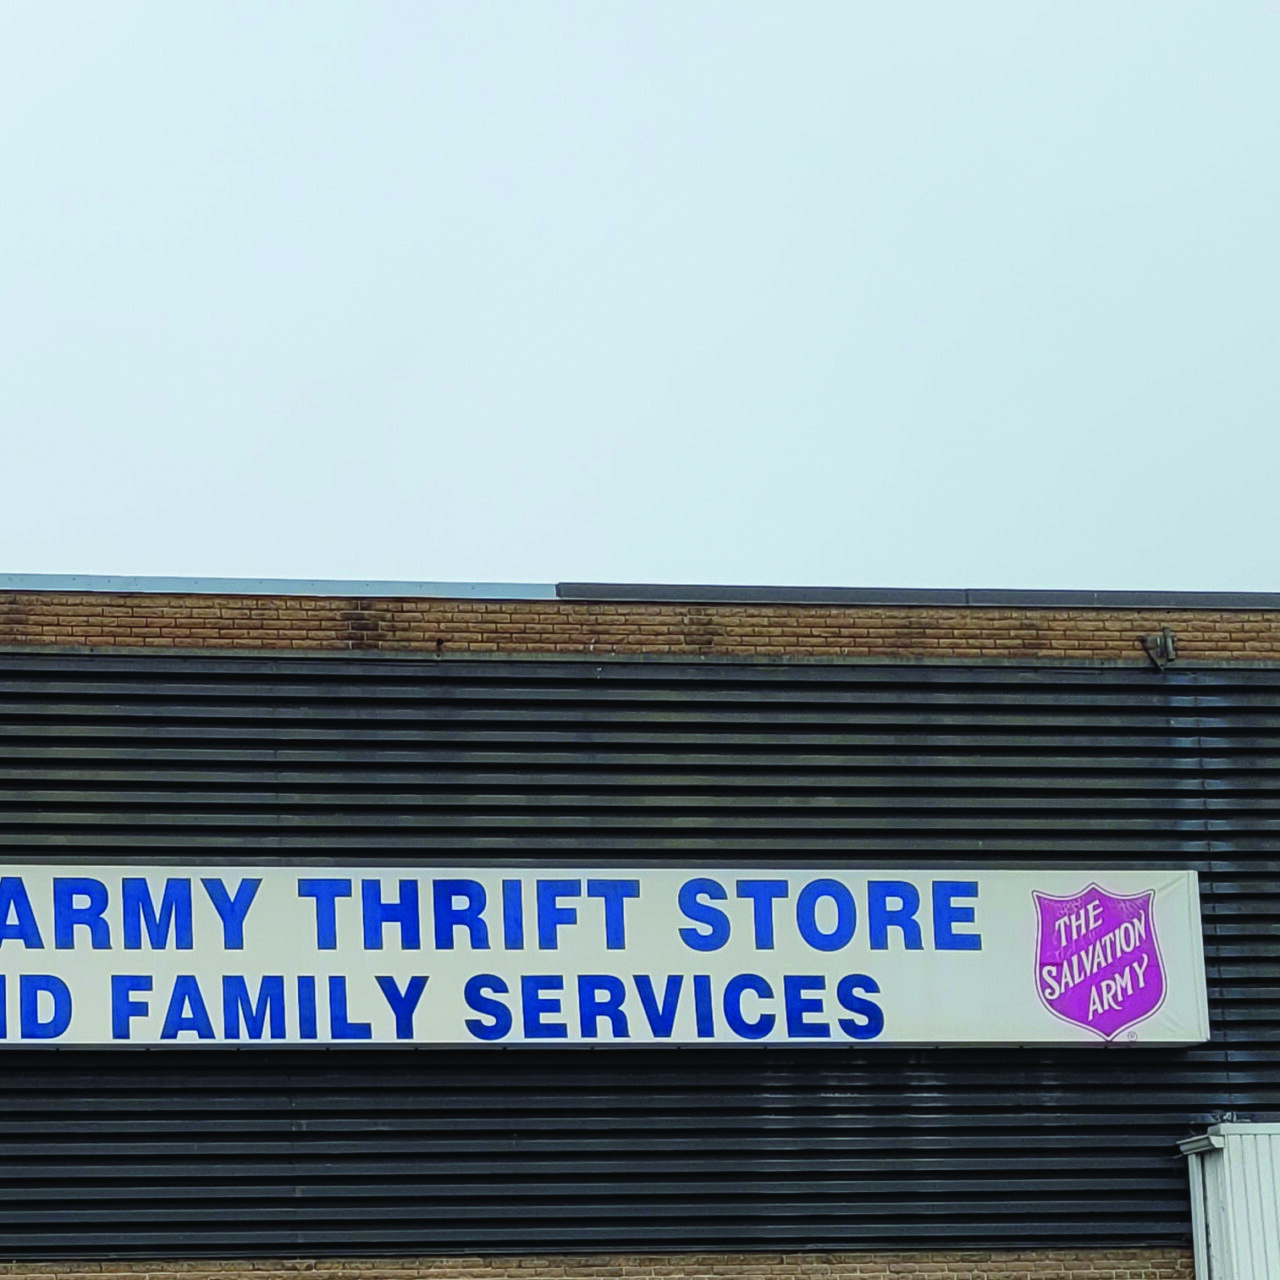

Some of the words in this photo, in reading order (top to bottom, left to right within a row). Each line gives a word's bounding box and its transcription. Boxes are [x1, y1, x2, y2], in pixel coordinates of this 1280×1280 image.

[297, 878, 641, 951] THRIFT
[676, 877, 982, 953] STORE
[1054, 899, 1104, 948] THE
[1041, 909, 1147, 1001] SALVATION
[1087, 953, 1149, 1022] ARMY
[110, 974, 427, 1041] FAMILY
[462, 973, 885, 1042] SERVICES
